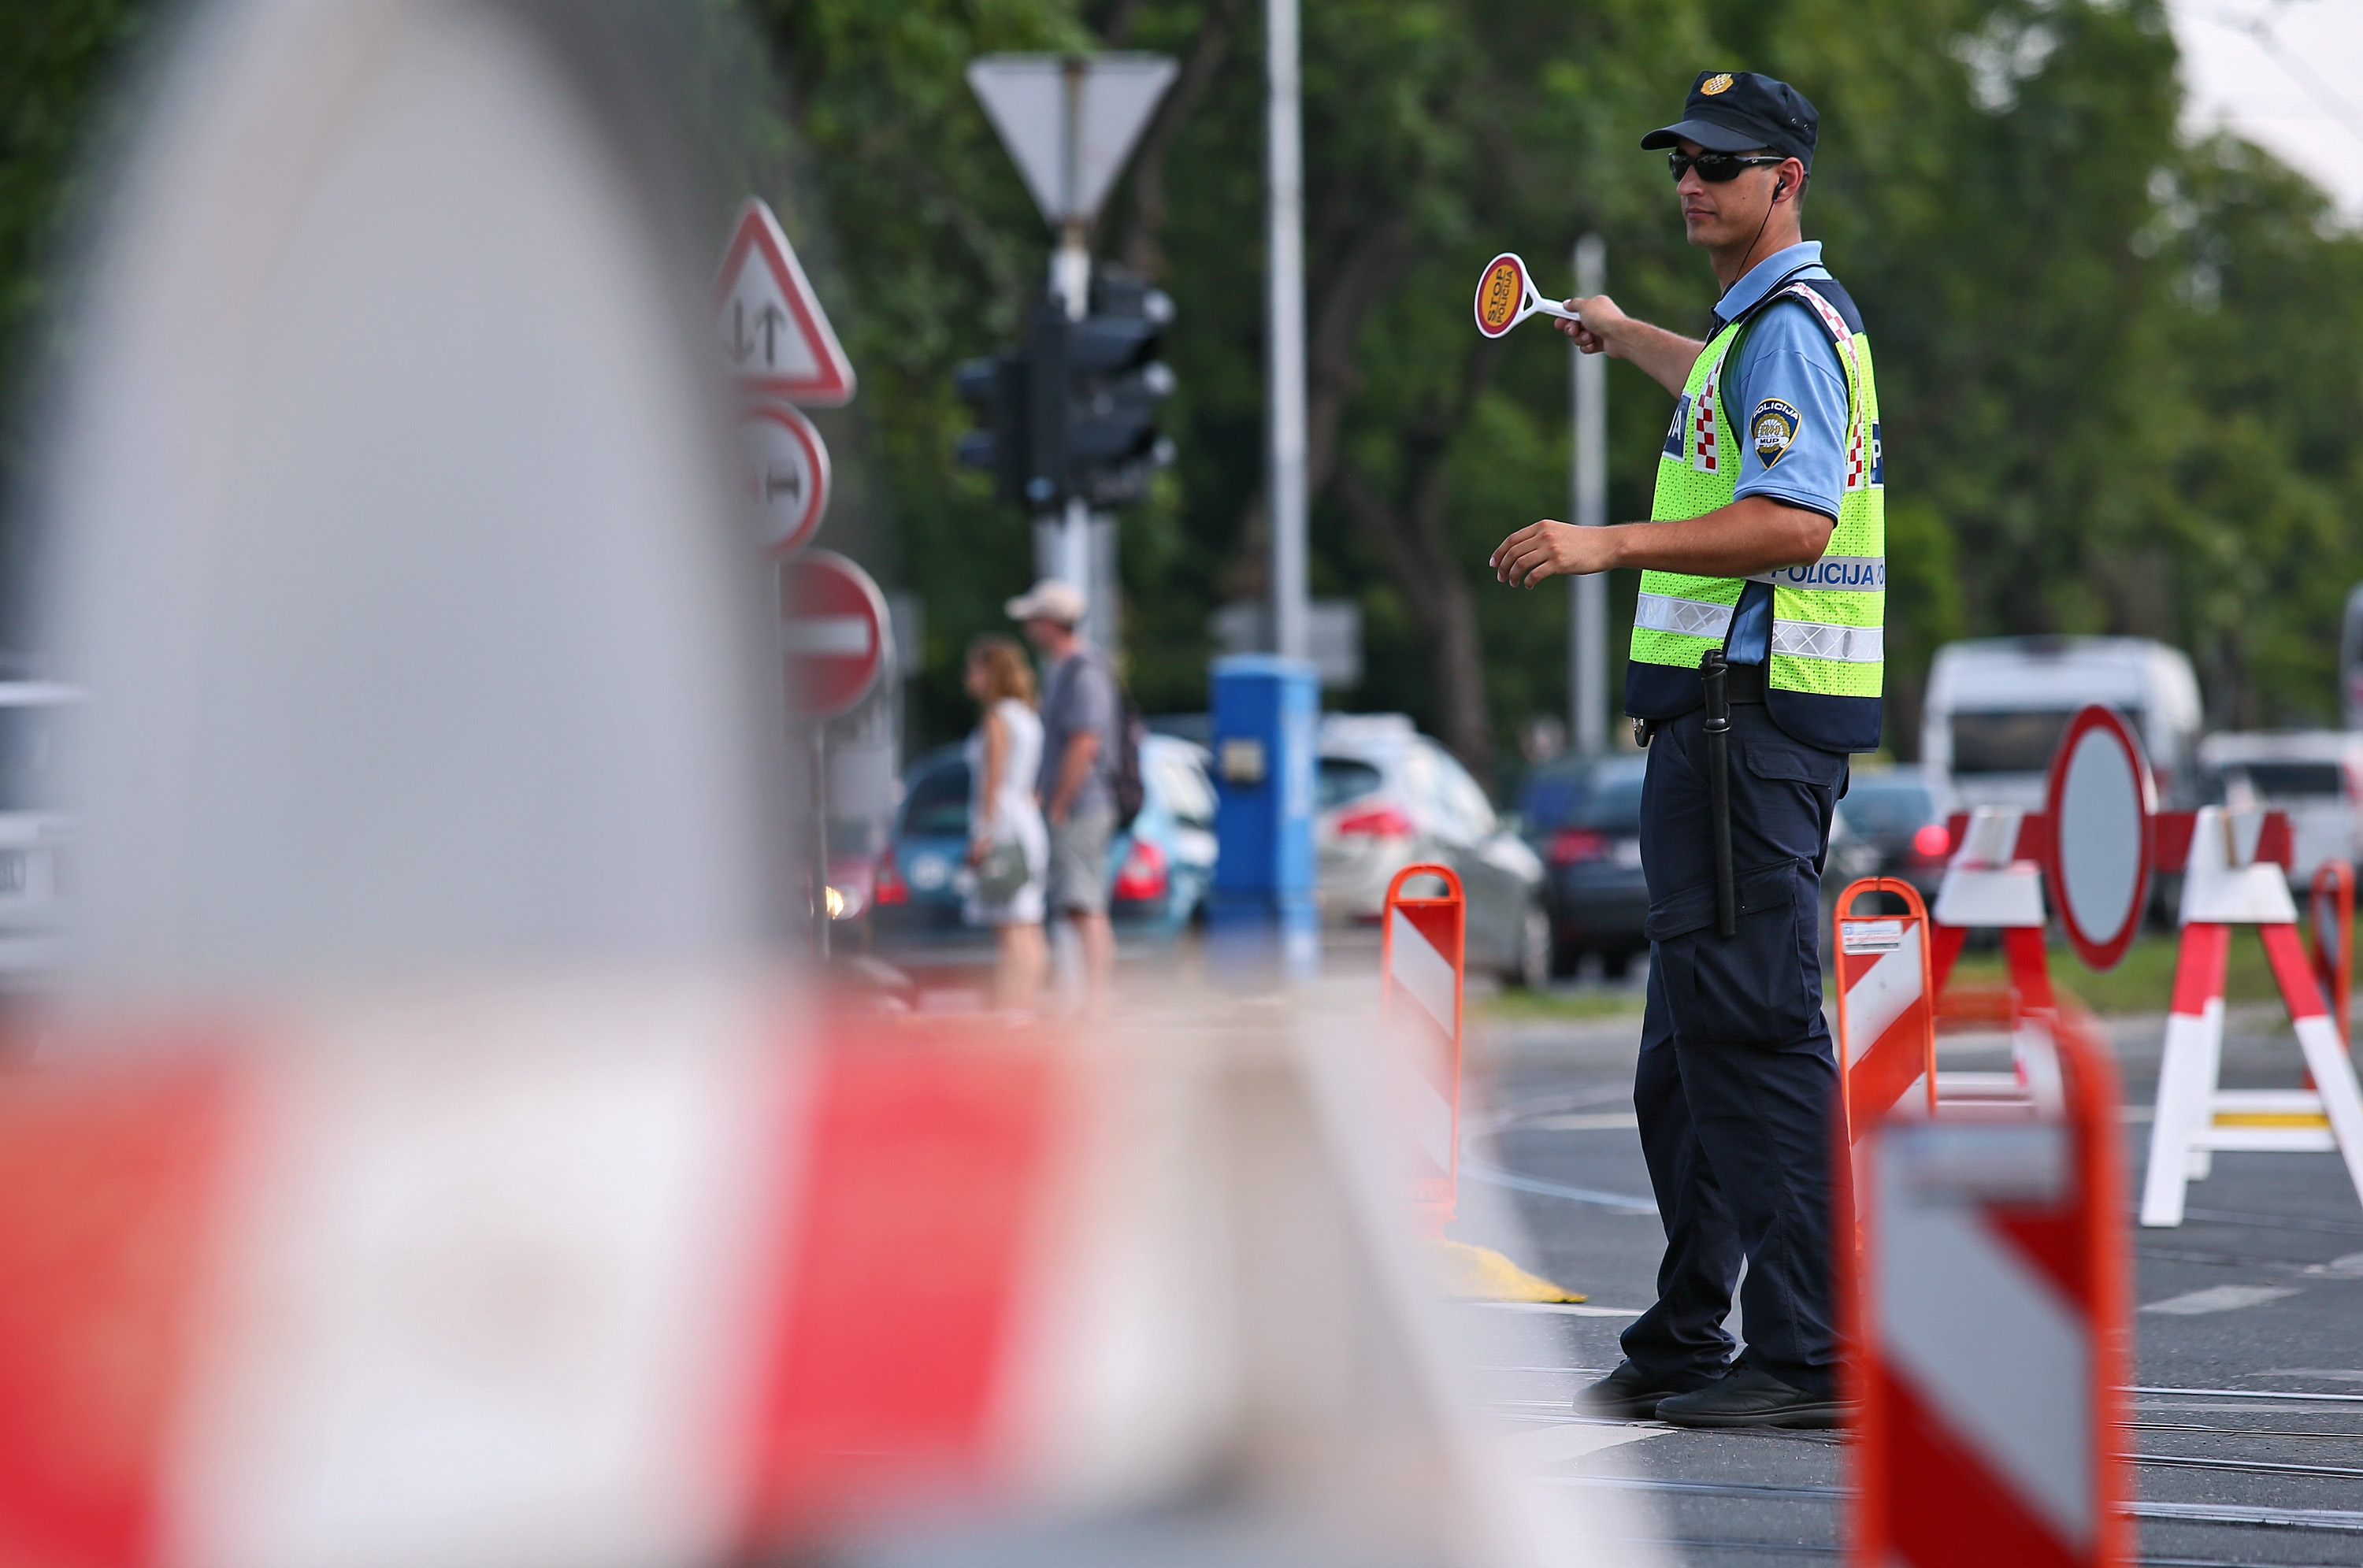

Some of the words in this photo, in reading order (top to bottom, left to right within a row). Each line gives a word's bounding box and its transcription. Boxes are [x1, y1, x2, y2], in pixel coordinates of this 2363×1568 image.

[1488, 269, 1504, 321] STOP
[1497, 271, 1513, 323] POLICIJA
[1753, 402, 1798, 420] POLICIJA
